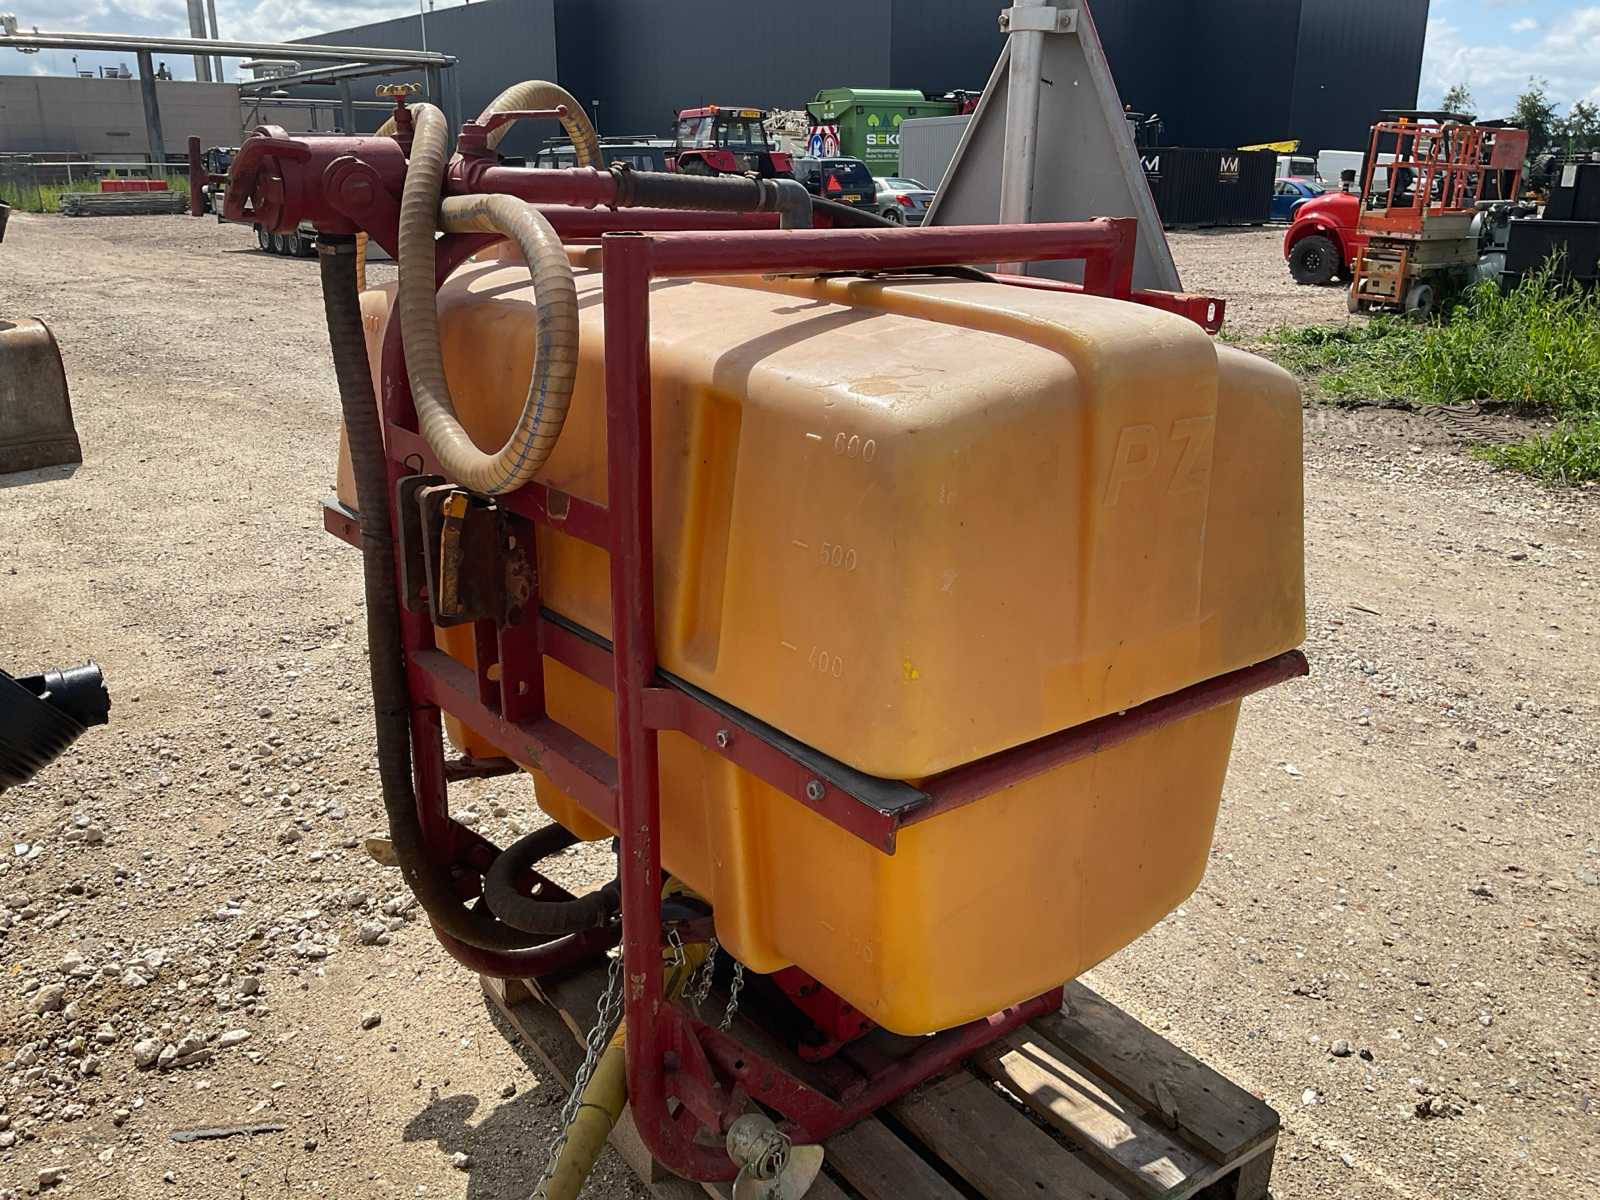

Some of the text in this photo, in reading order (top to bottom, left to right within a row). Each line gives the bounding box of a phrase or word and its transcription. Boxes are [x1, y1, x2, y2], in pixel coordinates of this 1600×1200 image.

[834, 431, 878, 464] 600
[1102, 414, 1217, 507] PZ
[820, 541, 858, 573] 500
[807, 645, 845, 679] 400
